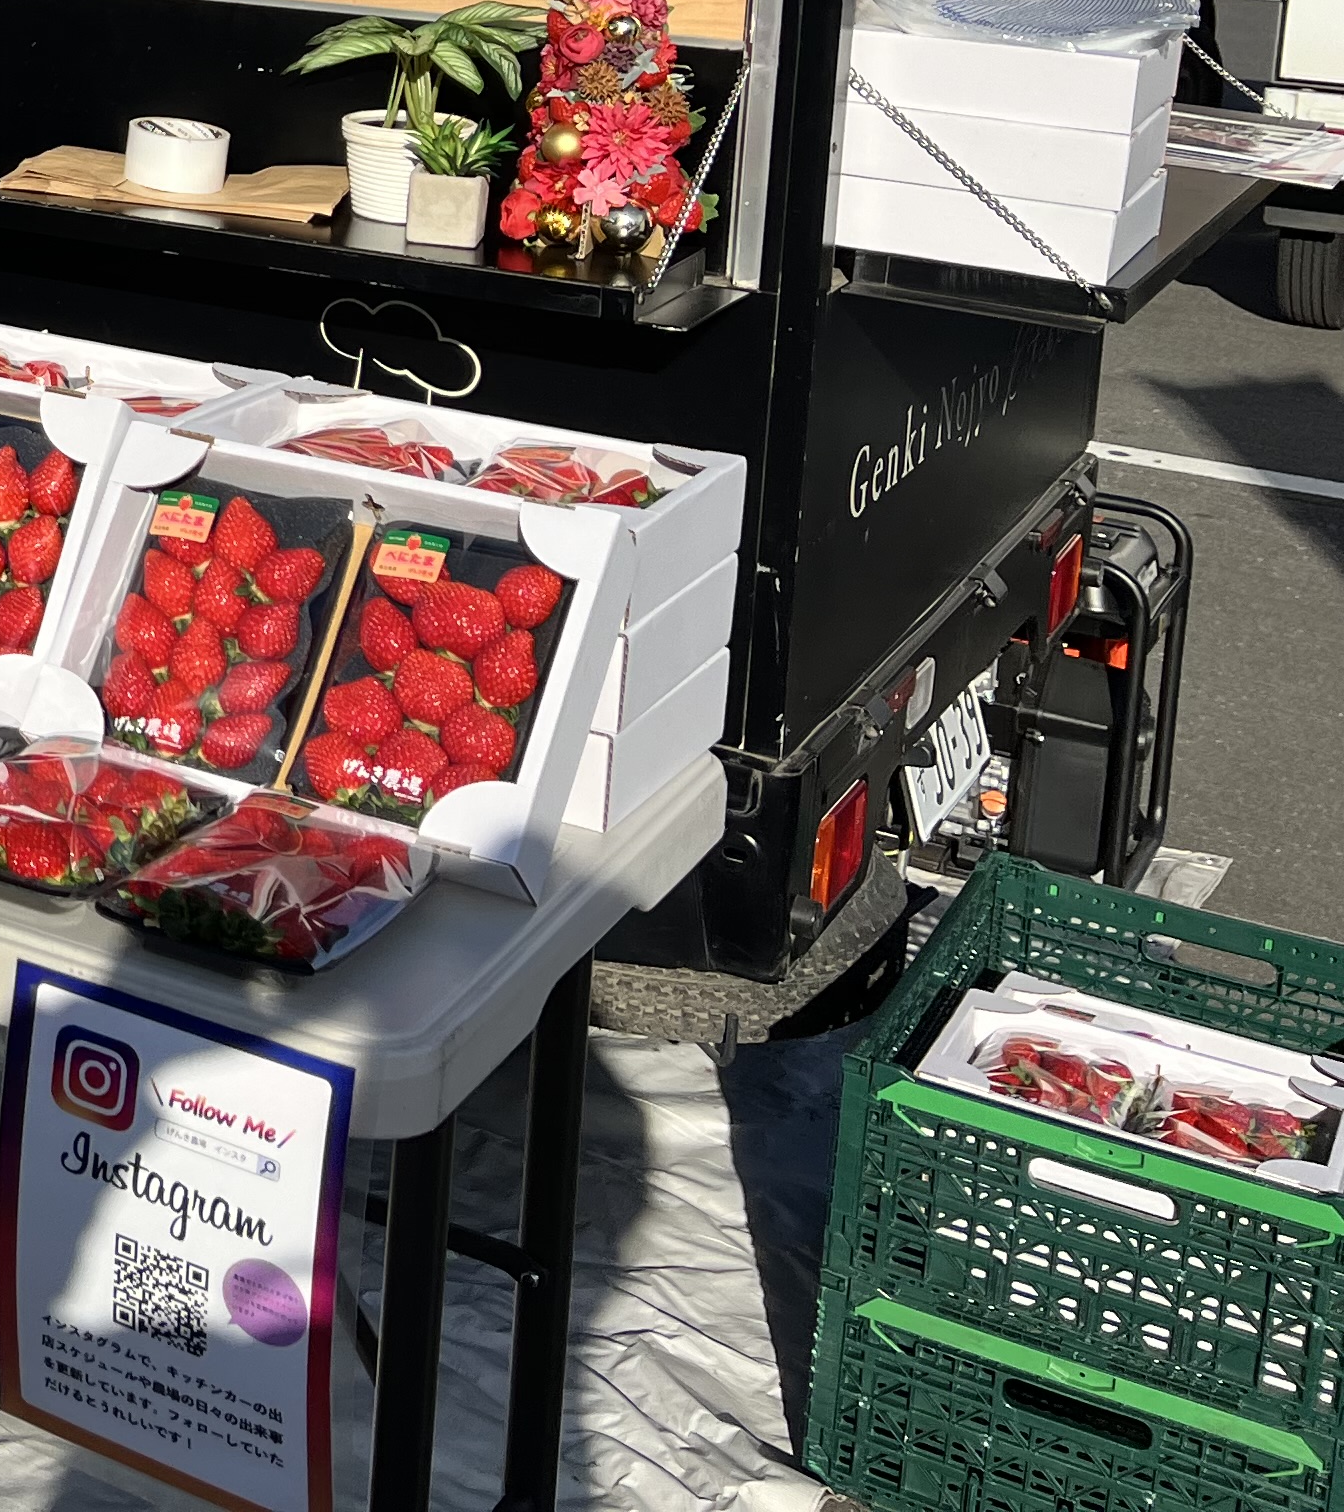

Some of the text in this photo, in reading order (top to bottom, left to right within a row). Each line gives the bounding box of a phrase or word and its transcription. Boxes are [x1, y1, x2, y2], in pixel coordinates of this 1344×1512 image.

[849, 403, 929, 518] Genki
[159, 510, 205, 528] べにたま
[384, 550, 435, 568] べにたま
[168, 1088, 277, 1144] Follow Me
[60, 1130, 274, 1247] Instagram
